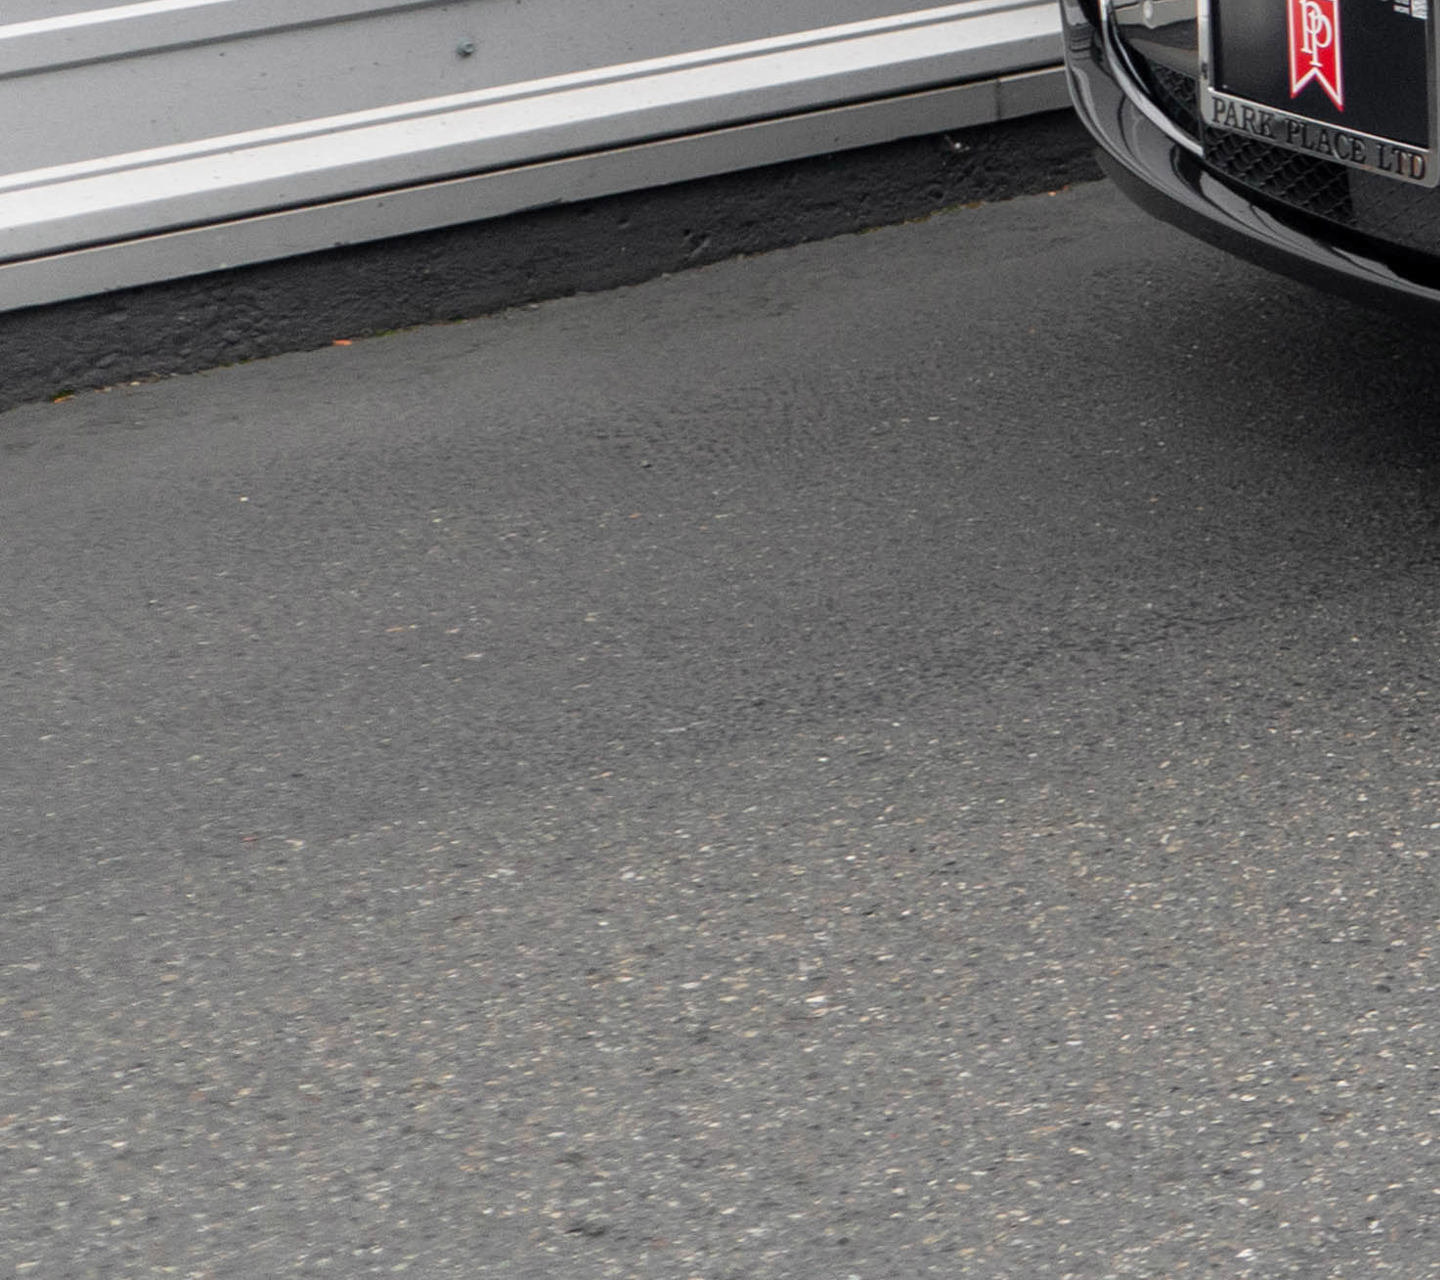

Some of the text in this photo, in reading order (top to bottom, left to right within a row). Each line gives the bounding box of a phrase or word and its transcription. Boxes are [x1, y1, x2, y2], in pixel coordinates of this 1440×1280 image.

[1211, 96, 1427, 181] PARK PLACE LTD
